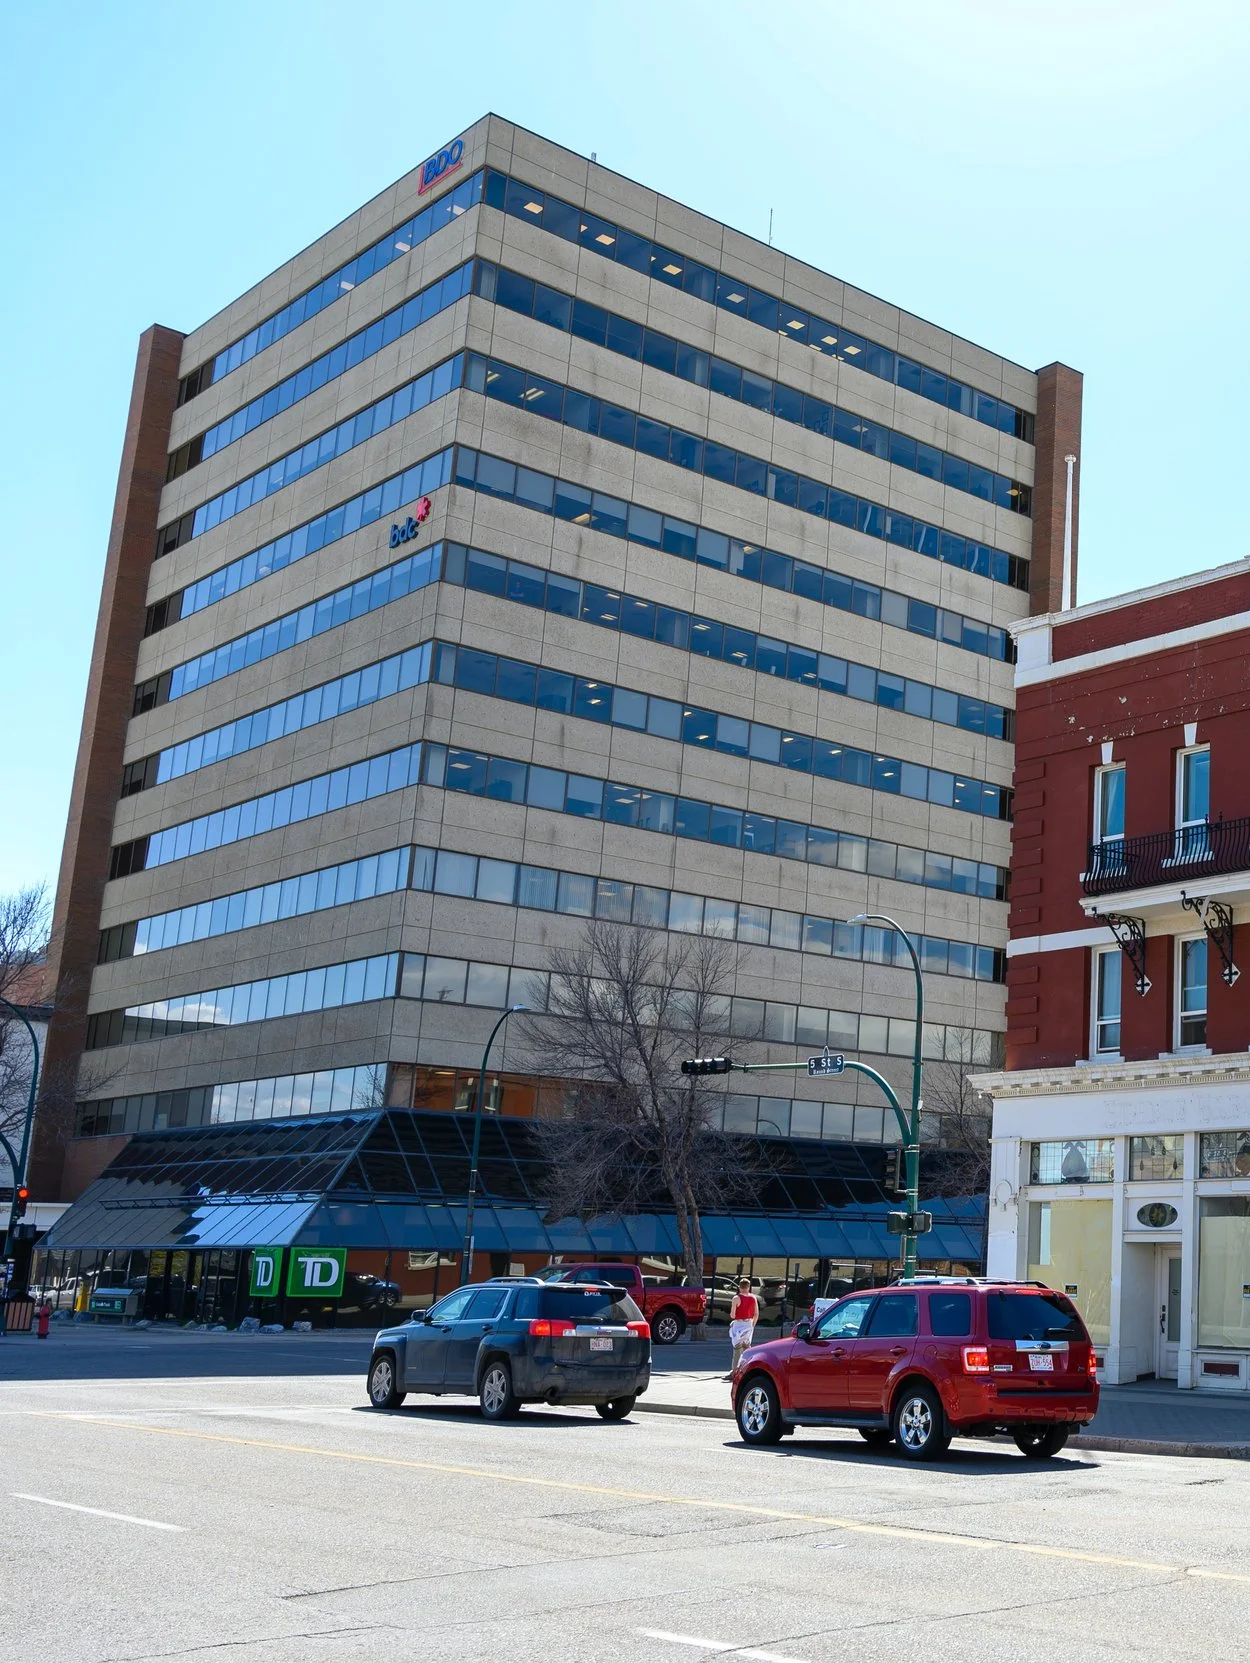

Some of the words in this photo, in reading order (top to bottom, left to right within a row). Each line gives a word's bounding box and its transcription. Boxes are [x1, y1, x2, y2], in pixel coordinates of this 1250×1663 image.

[424, 139, 464, 185] BDO
[389, 516, 420, 548] bdc
[810, 1060, 815, 1068] 5
[821, 1057, 831, 1067] St
[837, 1056, 842, 1066] S
[255, 1256, 273, 1287] TD
[297, 1256, 340, 1287] TD
